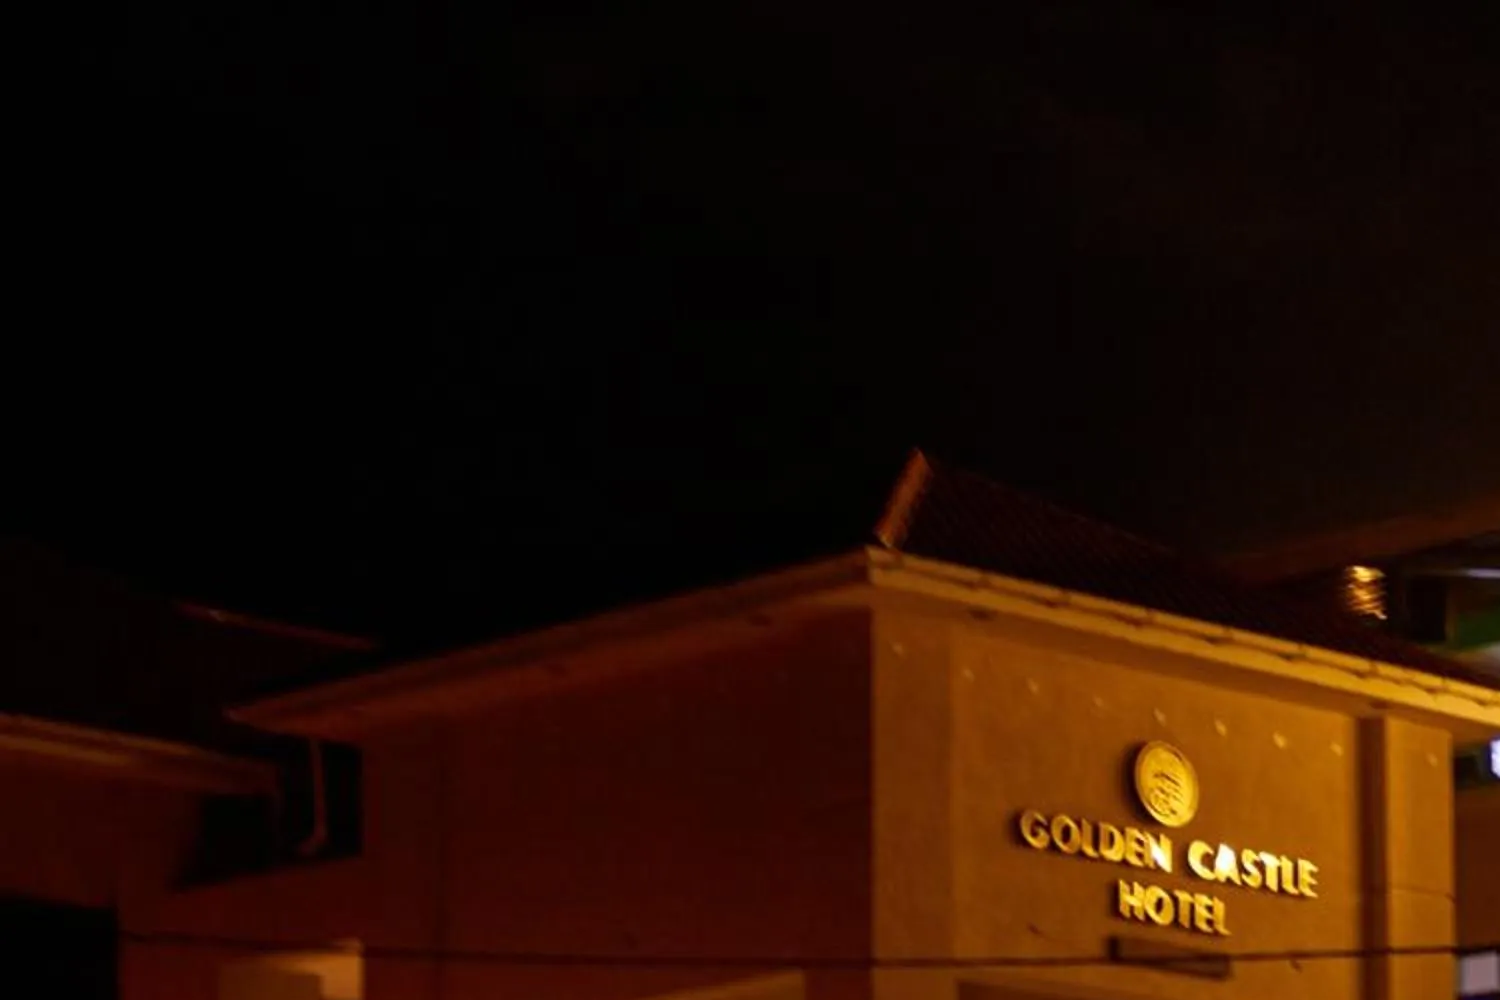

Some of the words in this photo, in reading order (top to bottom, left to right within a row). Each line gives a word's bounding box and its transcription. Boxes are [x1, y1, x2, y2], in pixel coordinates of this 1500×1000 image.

[1019, 810, 1173, 873] GOLDEN
[1187, 840, 1319, 898] CASTLE
[1118, 879, 1232, 935] HOTEL
